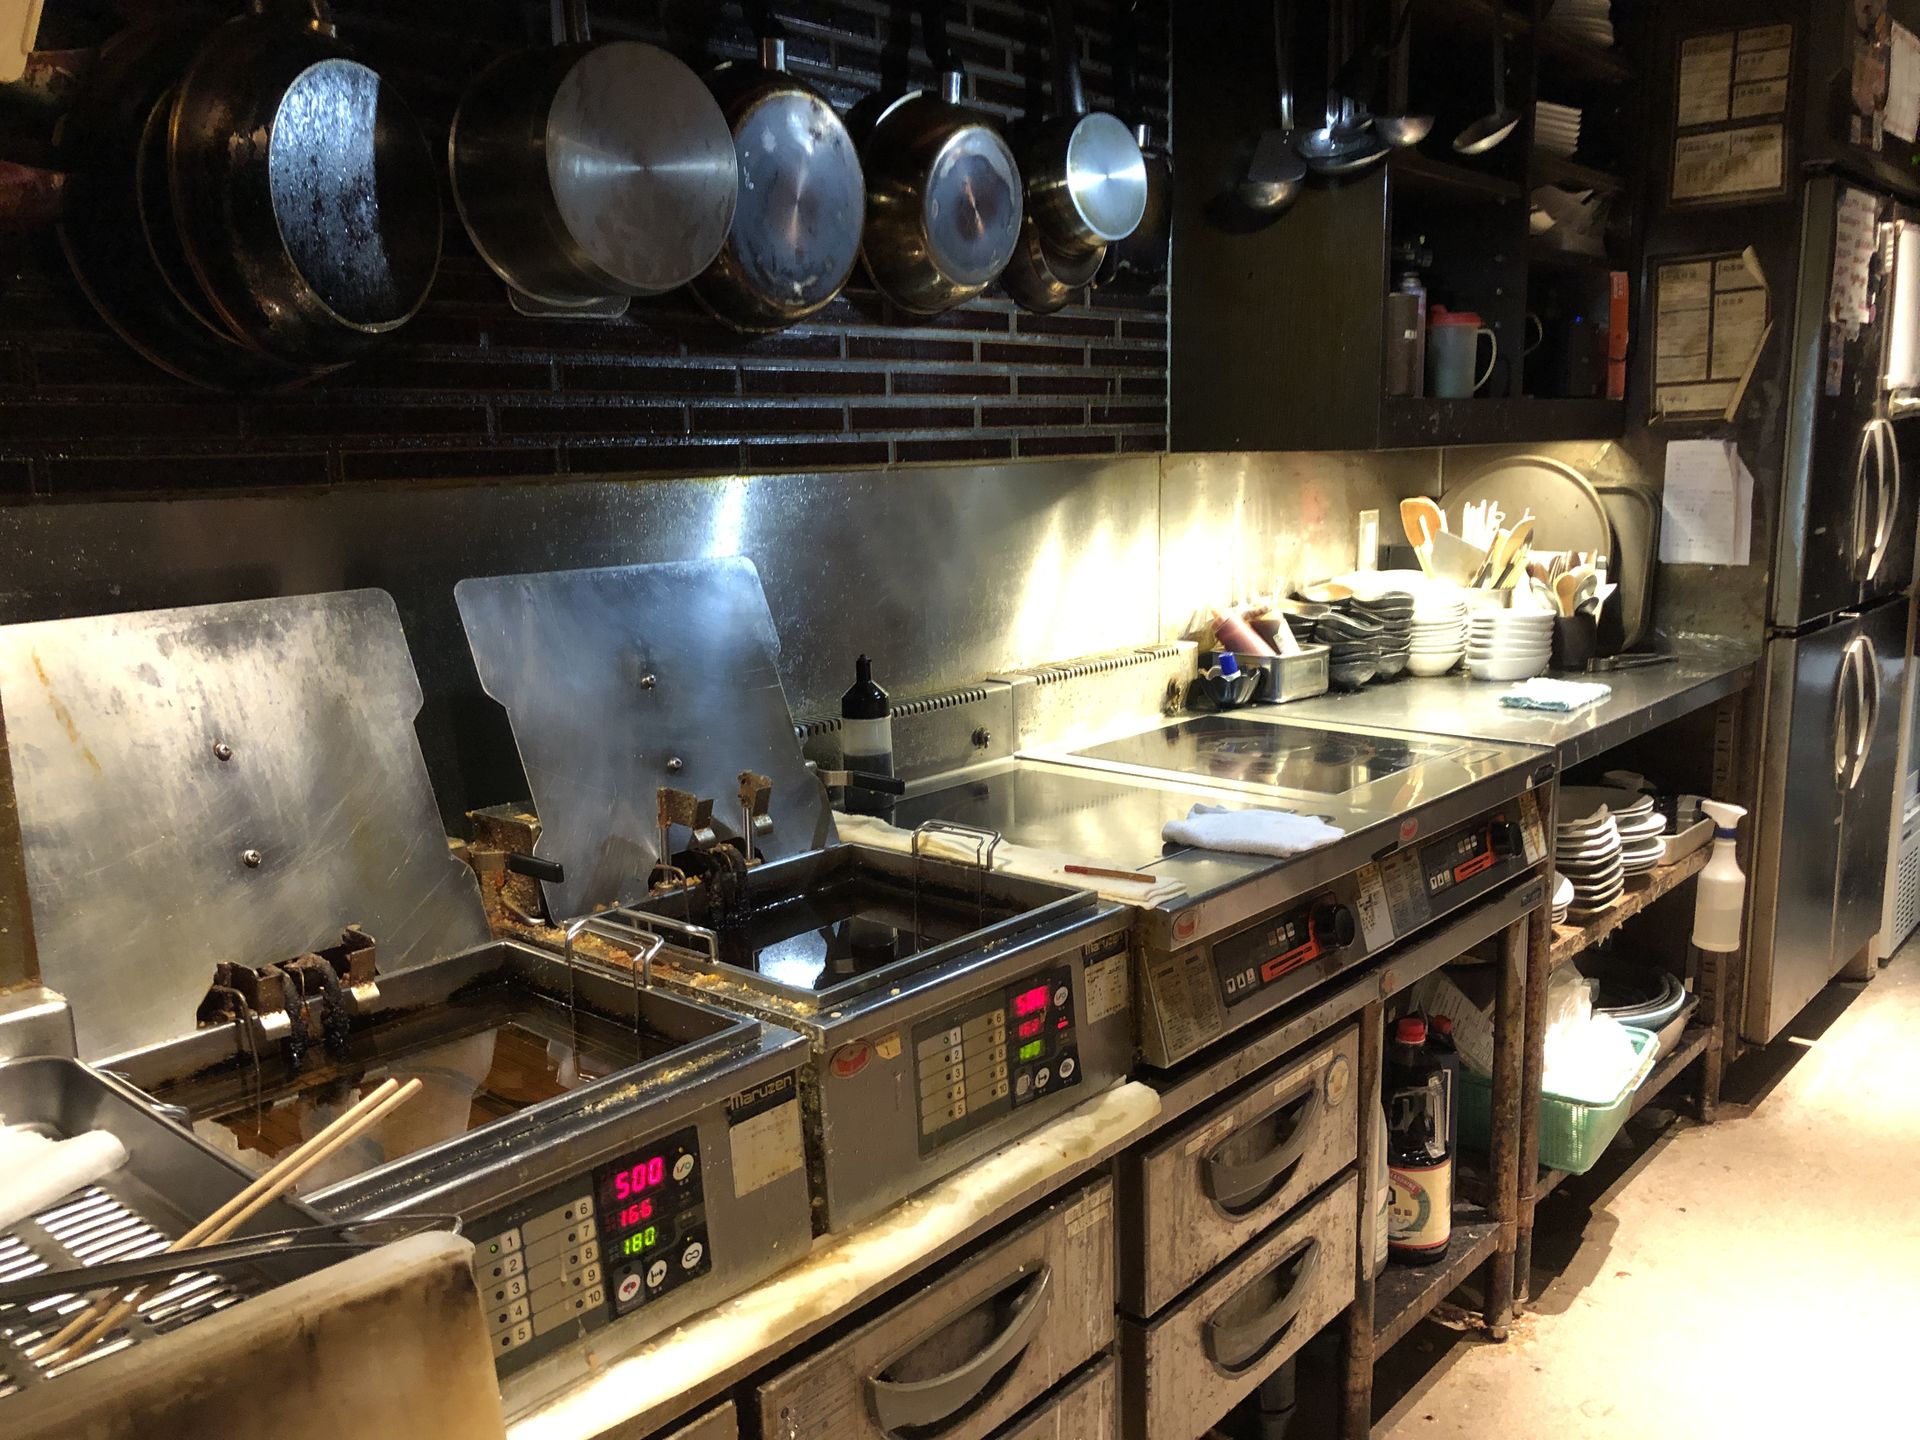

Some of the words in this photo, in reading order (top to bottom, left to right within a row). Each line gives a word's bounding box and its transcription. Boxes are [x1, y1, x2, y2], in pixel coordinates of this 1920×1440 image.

[615, 1156, 664, 1200] 500
[580, 1202, 588, 1215] 6
[583, 1224, 590, 1237] 7
[505, 1236, 513, 1247] 1
[624, 1226, 656, 1255] 180
[585, 1247, 593, 1259] 8
[510, 1259, 517, 1272] 2
[588, 1269, 595, 1281] 9
[512, 1281, 520, 1295] 3
[588, 1290, 601, 1304] 10
[515, 1305, 522, 1316] 4
[518, 1329, 525, 1340] 5
